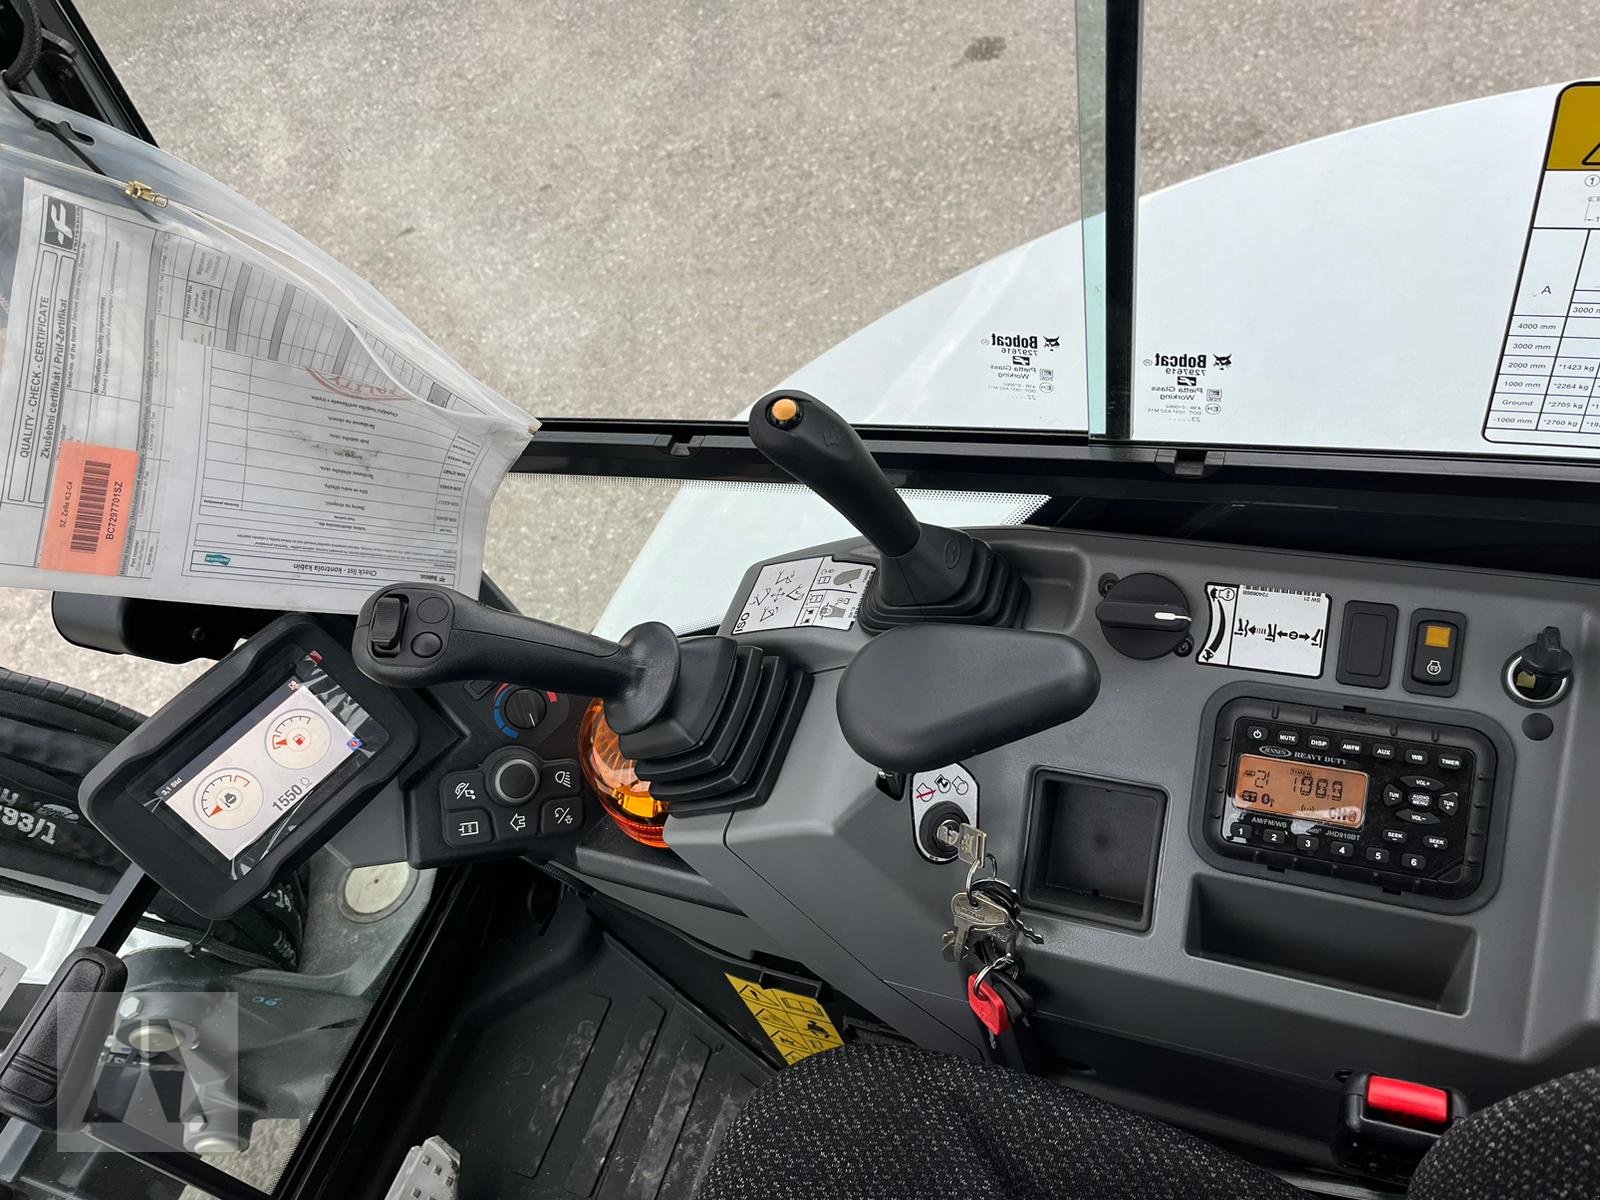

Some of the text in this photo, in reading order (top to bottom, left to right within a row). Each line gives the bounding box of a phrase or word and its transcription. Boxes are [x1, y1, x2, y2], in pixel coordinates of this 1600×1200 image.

[1540, 285, 1552, 294] A
[53, 298, 67, 363] Prüf-Zertifikat
[19, 414, 34, 457] QUALITY
[27, 370, 41, 406] CHECK
[34, 295, 48, 362] CERTIFICATE
[46, 370, 60, 413] certifikát
[39, 415, 55, 458] Zkušební
[105, 481, 123, 539] BC7297701SZ
[293, 562, 312, 571] kabin
[314, 563, 342, 573] kontrola
[358, 567, 376, 576] Check
[734, 612, 750, 632] ISO
[1280, 734, 1296, 742] MUTE
[1310, 739, 1328, 748] DISP
[1376, 748, 1391, 756] AUX
[1294, 752, 1348, 766] HEAVY DUTY
[1441, 758, 1460, 766] TIMER
[170, 777, 183, 790] Std
[272, 785, 303, 813] 1550
[0, 805, 56, 846] 93/1
[1251, 816, 1288, 828] AM/FM/WB
[1238, 827, 1244, 835] 1
[1270, 833, 1277, 842] 2
[1324, 830, 1360, 842] JHD910BT
[1387, 832, 1403, 840] SEEK
[1304, 840, 1311, 848] 3
[1428, 838, 1445, 846] SEEK
[1375, 852, 1381, 860] 5
[1410, 858, 1417, 866] 6
